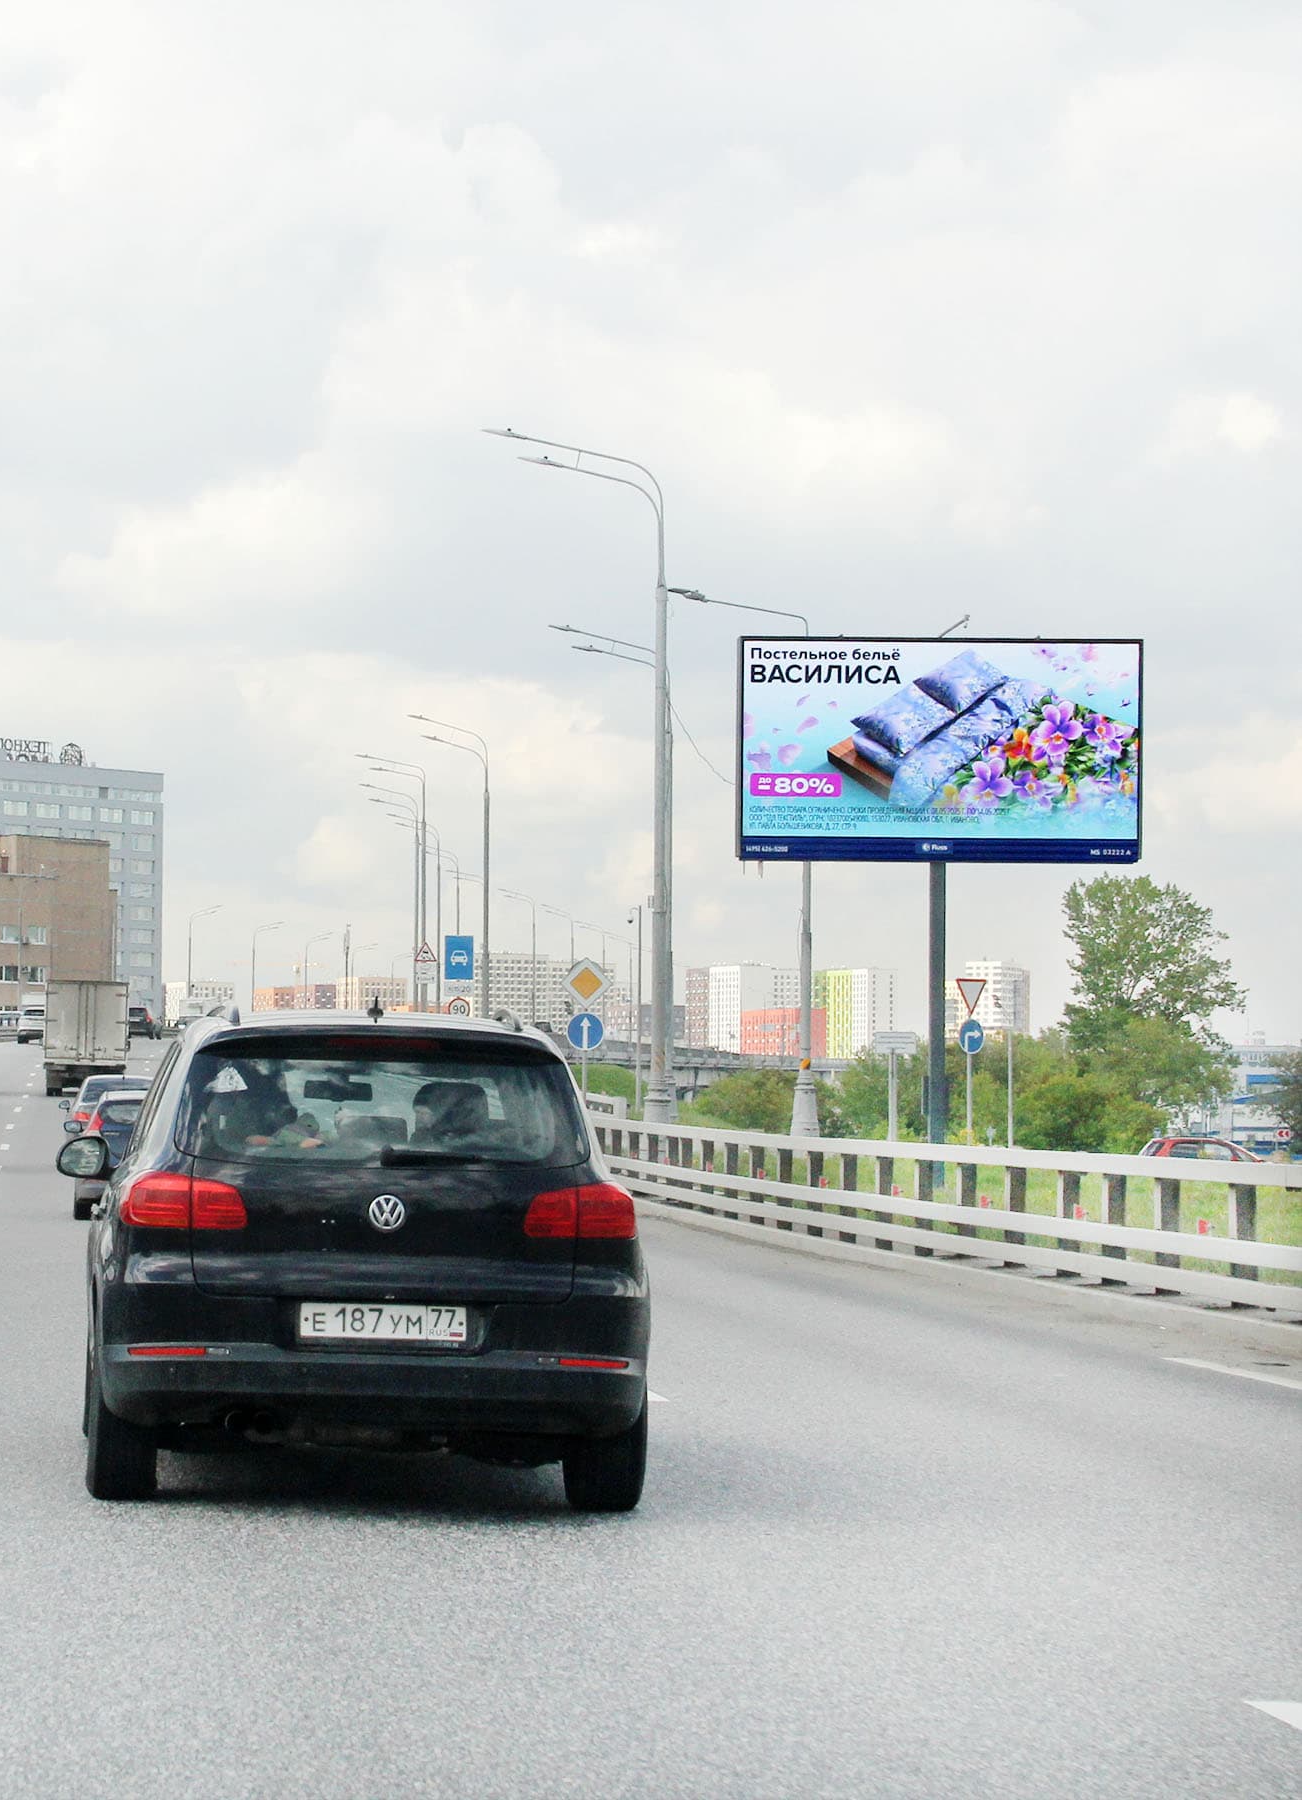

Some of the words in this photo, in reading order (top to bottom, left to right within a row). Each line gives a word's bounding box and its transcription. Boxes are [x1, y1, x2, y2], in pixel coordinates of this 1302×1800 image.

[750, 647, 848, 660] Постельное
[852, 647, 901, 660] бельё
[750, 664, 901, 684] ВАСИЛИСА
[452, 1004, 466, 1015] 90
[430, 1308, 456, 1328] 77
